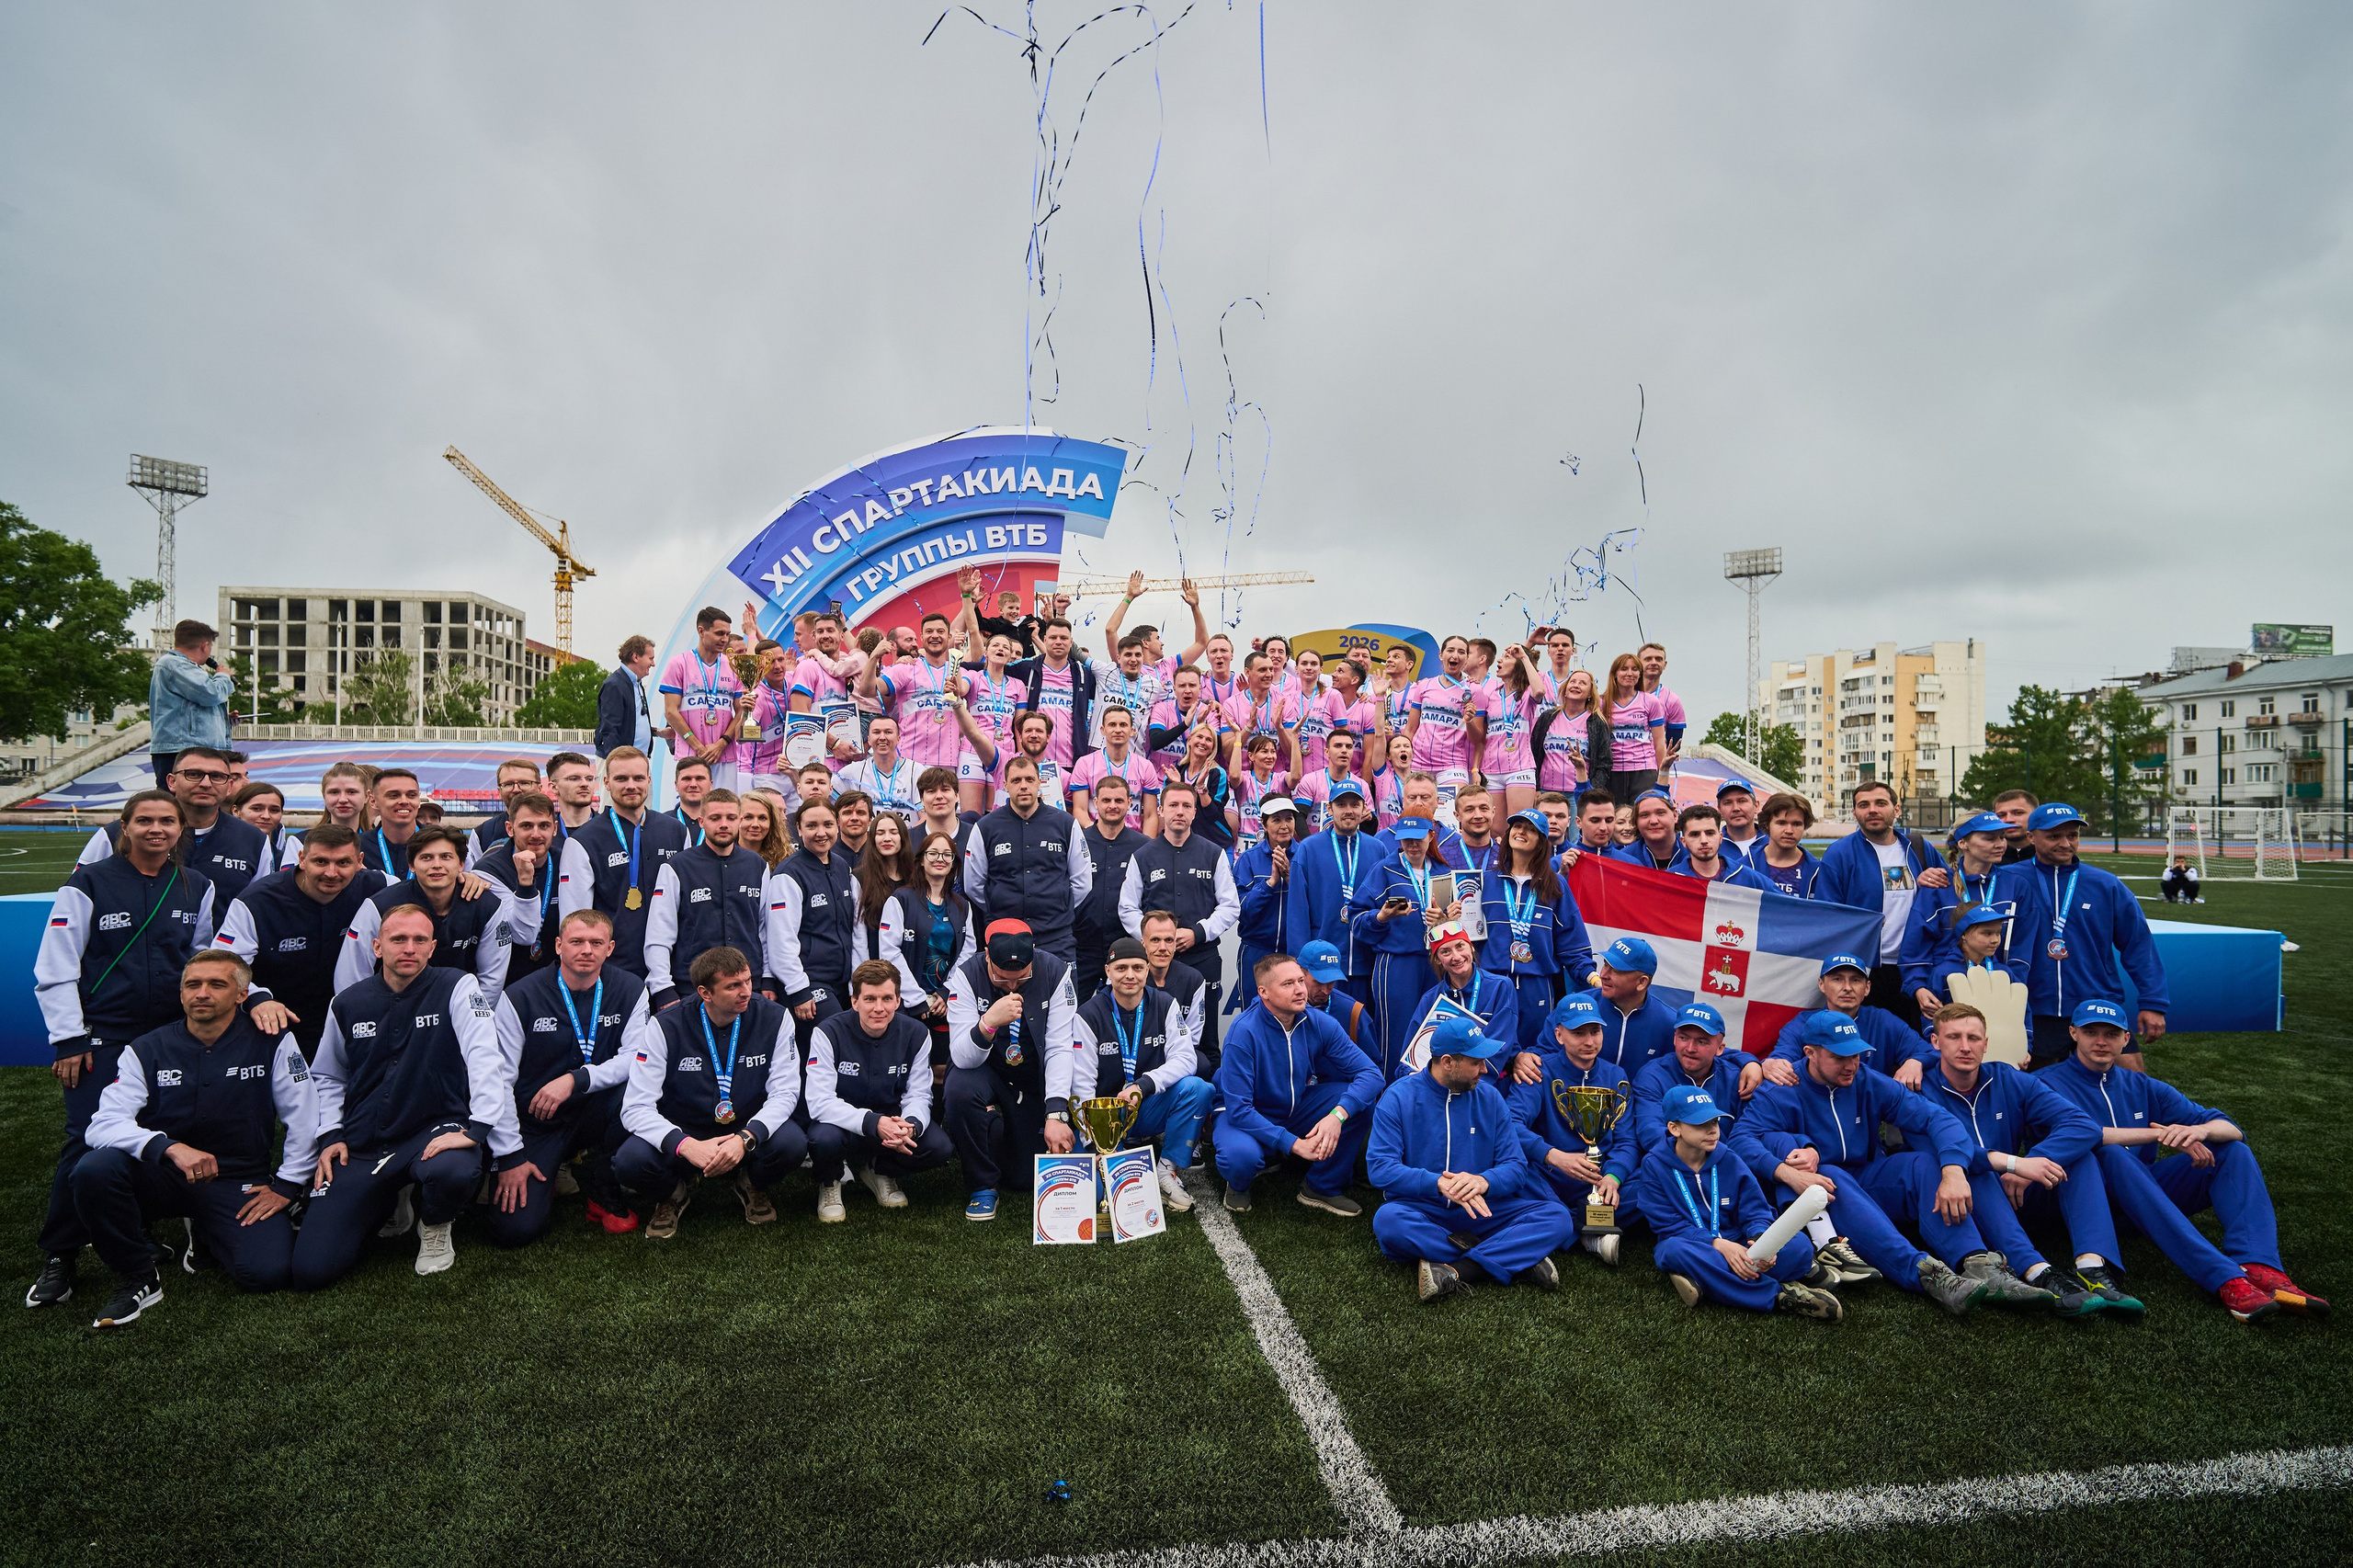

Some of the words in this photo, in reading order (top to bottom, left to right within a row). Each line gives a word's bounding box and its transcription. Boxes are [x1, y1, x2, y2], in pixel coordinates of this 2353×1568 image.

[760, 546, 813, 597] XII
[812, 466, 1105, 553] СПАРТАКИАДА
[845, 529, 978, 602] ГРУППЫ
[984, 523, 1048, 549] ВТБ
[1339, 635, 1381, 651] 2026
[1610, 732, 1643, 740] АМАРА
[961, 765, 970, 775] 8
[1048, 843, 1063, 853] ВТБ
[224, 858, 247, 871] ВТБ
[1196, 869, 1212, 880] ВТБ
[1795, 869, 1802, 879] 1
[747, 888, 761, 898] ВТБ
[182, 912, 198, 925] ВТБ
[1617, 943, 1631, 955] ВТБ
[1577, 1003, 1593, 1011] ВТБ
[2096, 1006, 2117, 1017] ВТБ
[1693, 1010, 1711, 1020] ВТБ
[415, 1014, 439, 1028] ВТБ
[603, 1014, 621, 1027] ВТБ
[1843, 1025, 1858, 1035] ВТБ
[746, 1054, 767, 1068] ВТБ
[240, 1065, 266, 1080] ВТБ
[1695, 1095, 1712, 1104] ВТБ
[1051, 1170, 1085, 1178] СПАРТАКИАДА
[1119, 1165, 1147, 1175] СПАРТАКИАДА
[1123, 1186, 1143, 1194] ДИПЛОМ
